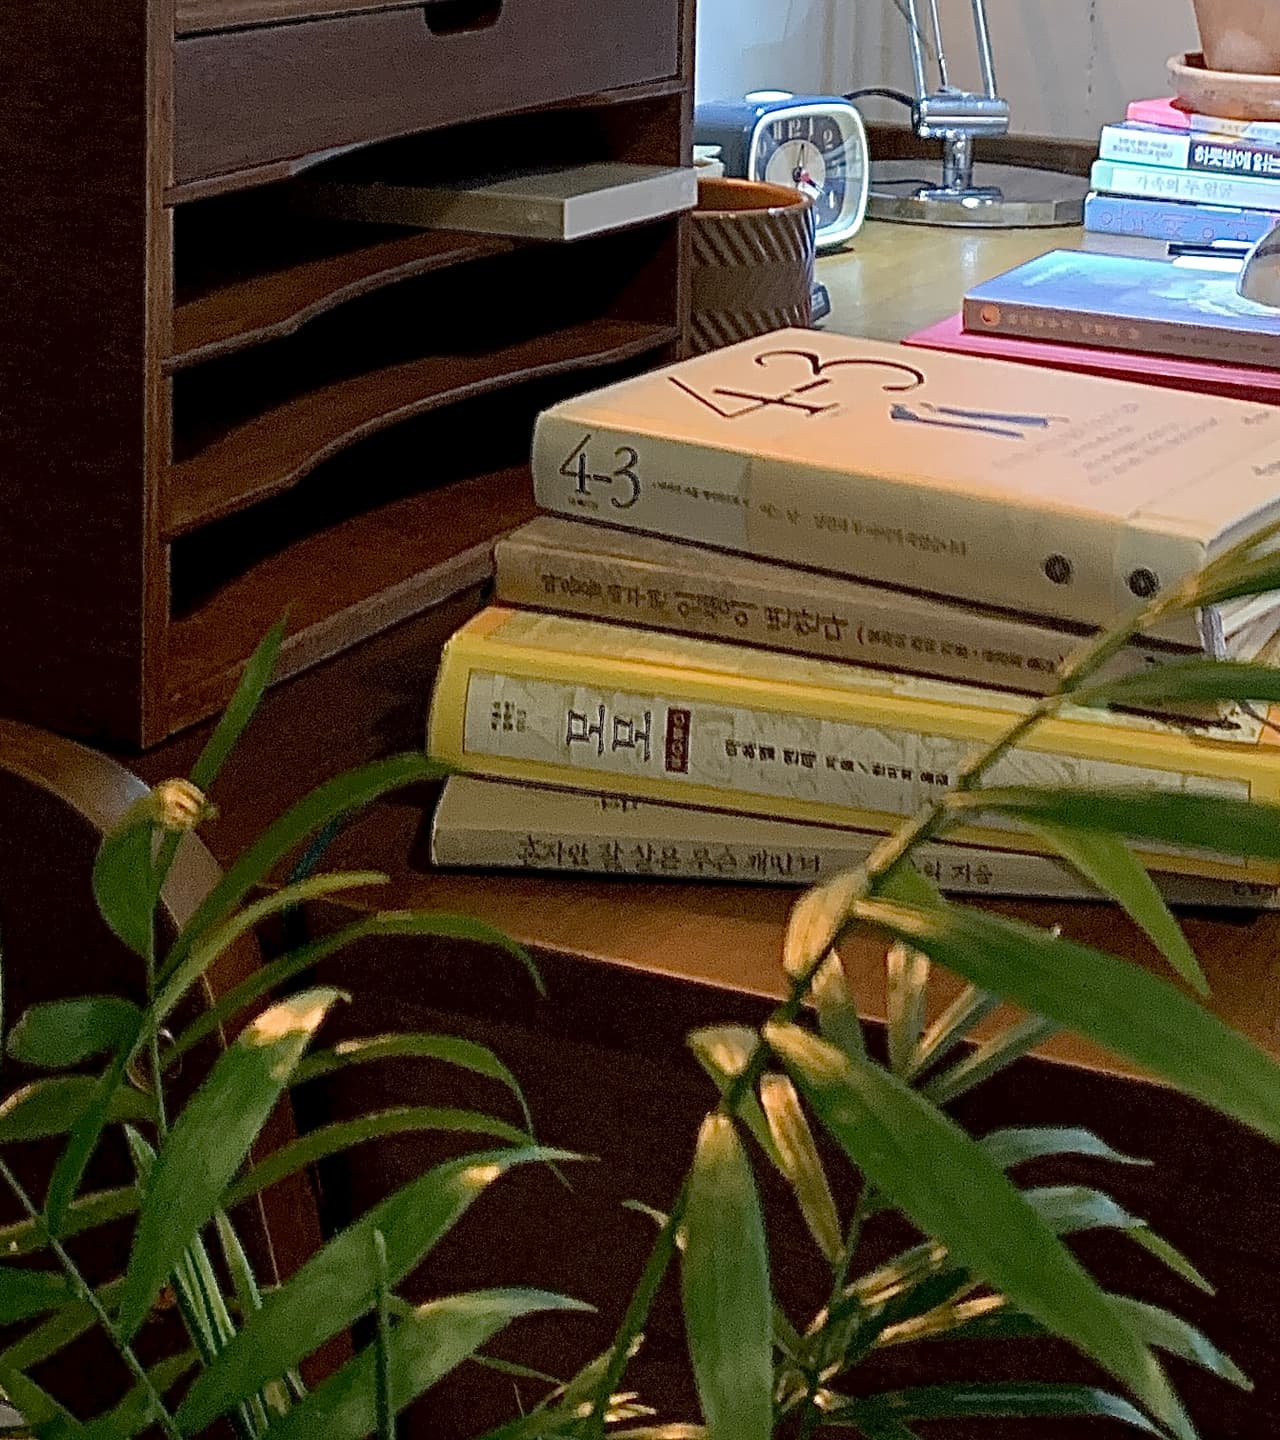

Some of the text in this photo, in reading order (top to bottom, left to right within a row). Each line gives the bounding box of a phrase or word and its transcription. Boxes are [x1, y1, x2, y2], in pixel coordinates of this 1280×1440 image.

[823, 129, 834, 148] 2
[1195, 145, 1252, 170] 하룻밤에
[566, 705, 651, 762] 모모
